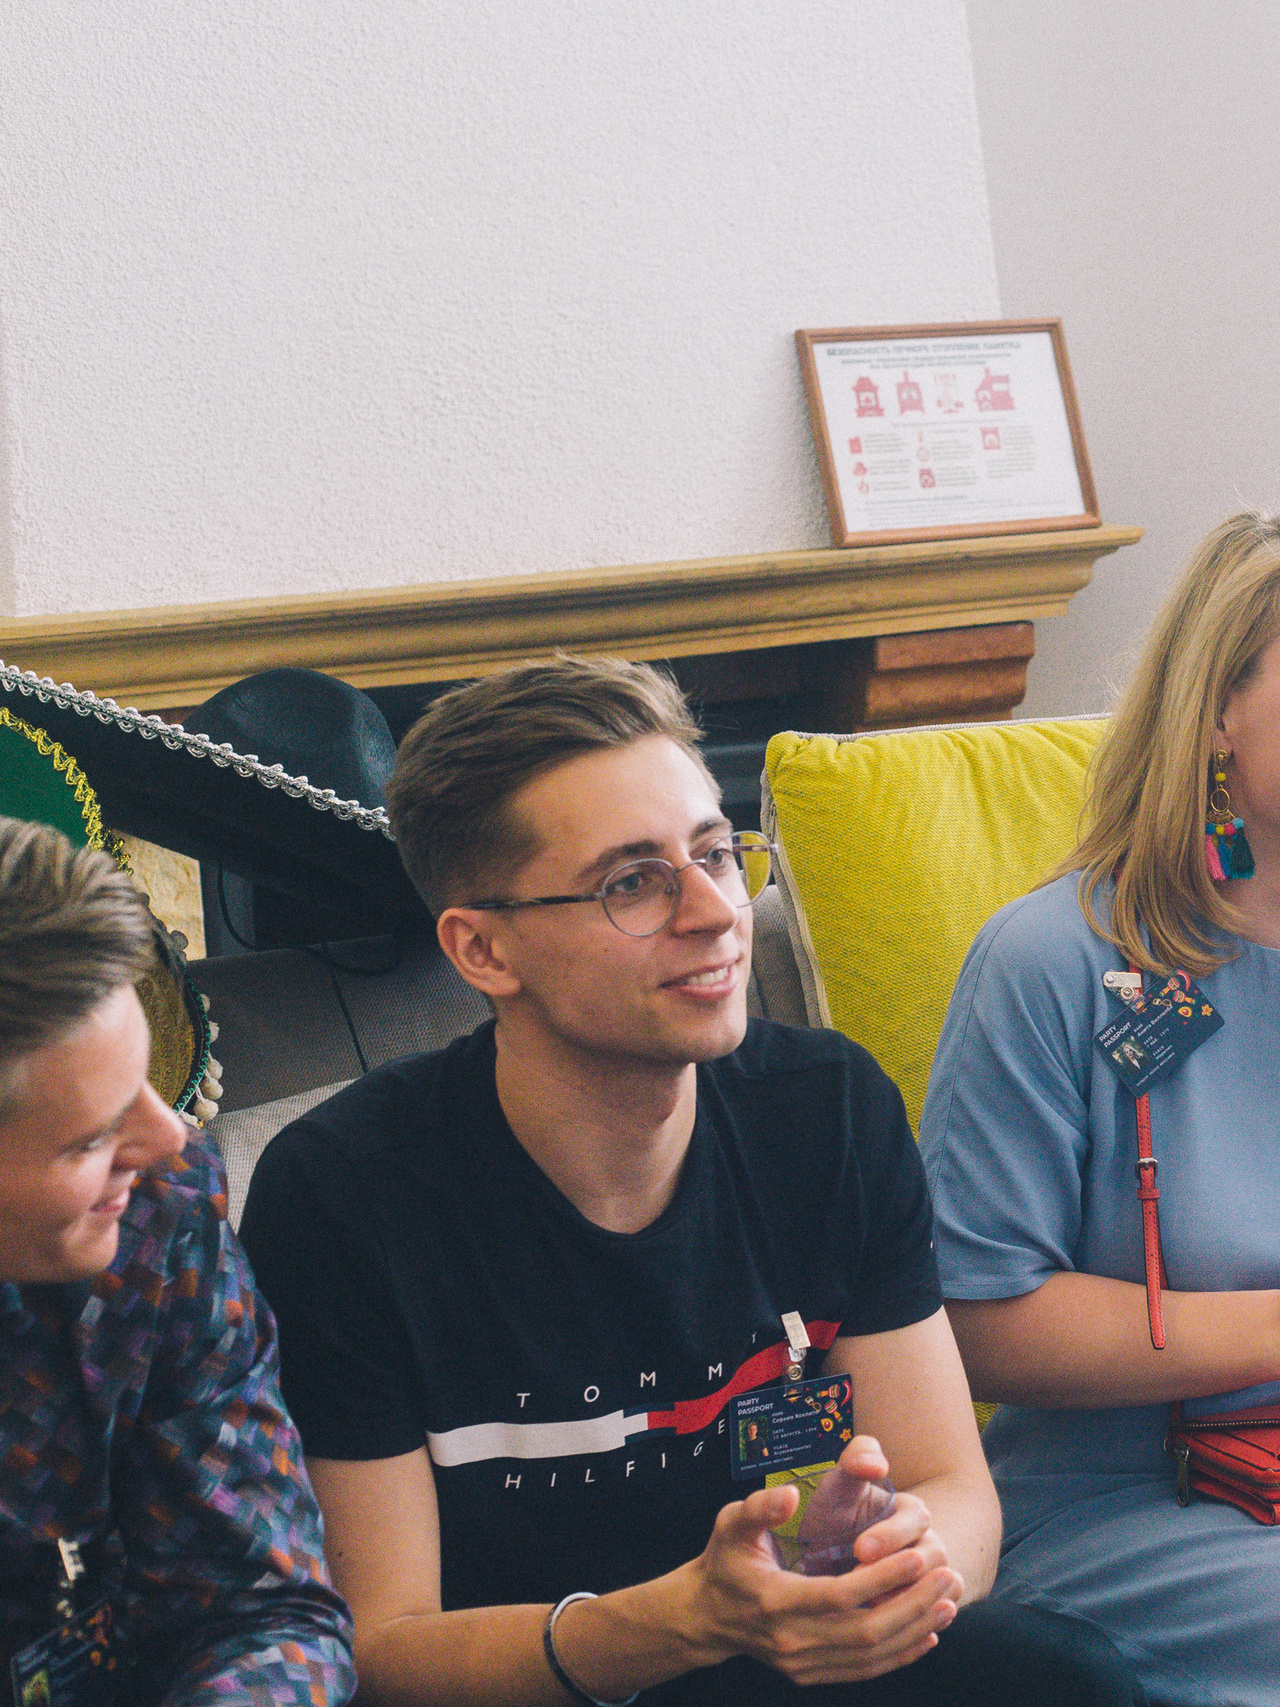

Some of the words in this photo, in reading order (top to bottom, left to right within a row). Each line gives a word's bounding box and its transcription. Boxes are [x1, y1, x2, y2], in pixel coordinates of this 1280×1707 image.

[1099, 1025, 1117, 1042] PARTY
[1104, 1022, 1132, 1048] PASSPORT
[737, 1398, 760, 1407] PARTY
[737, 1403, 774, 1416] PASSPORT
[505, 1419, 726, 1489] HILFIGE
